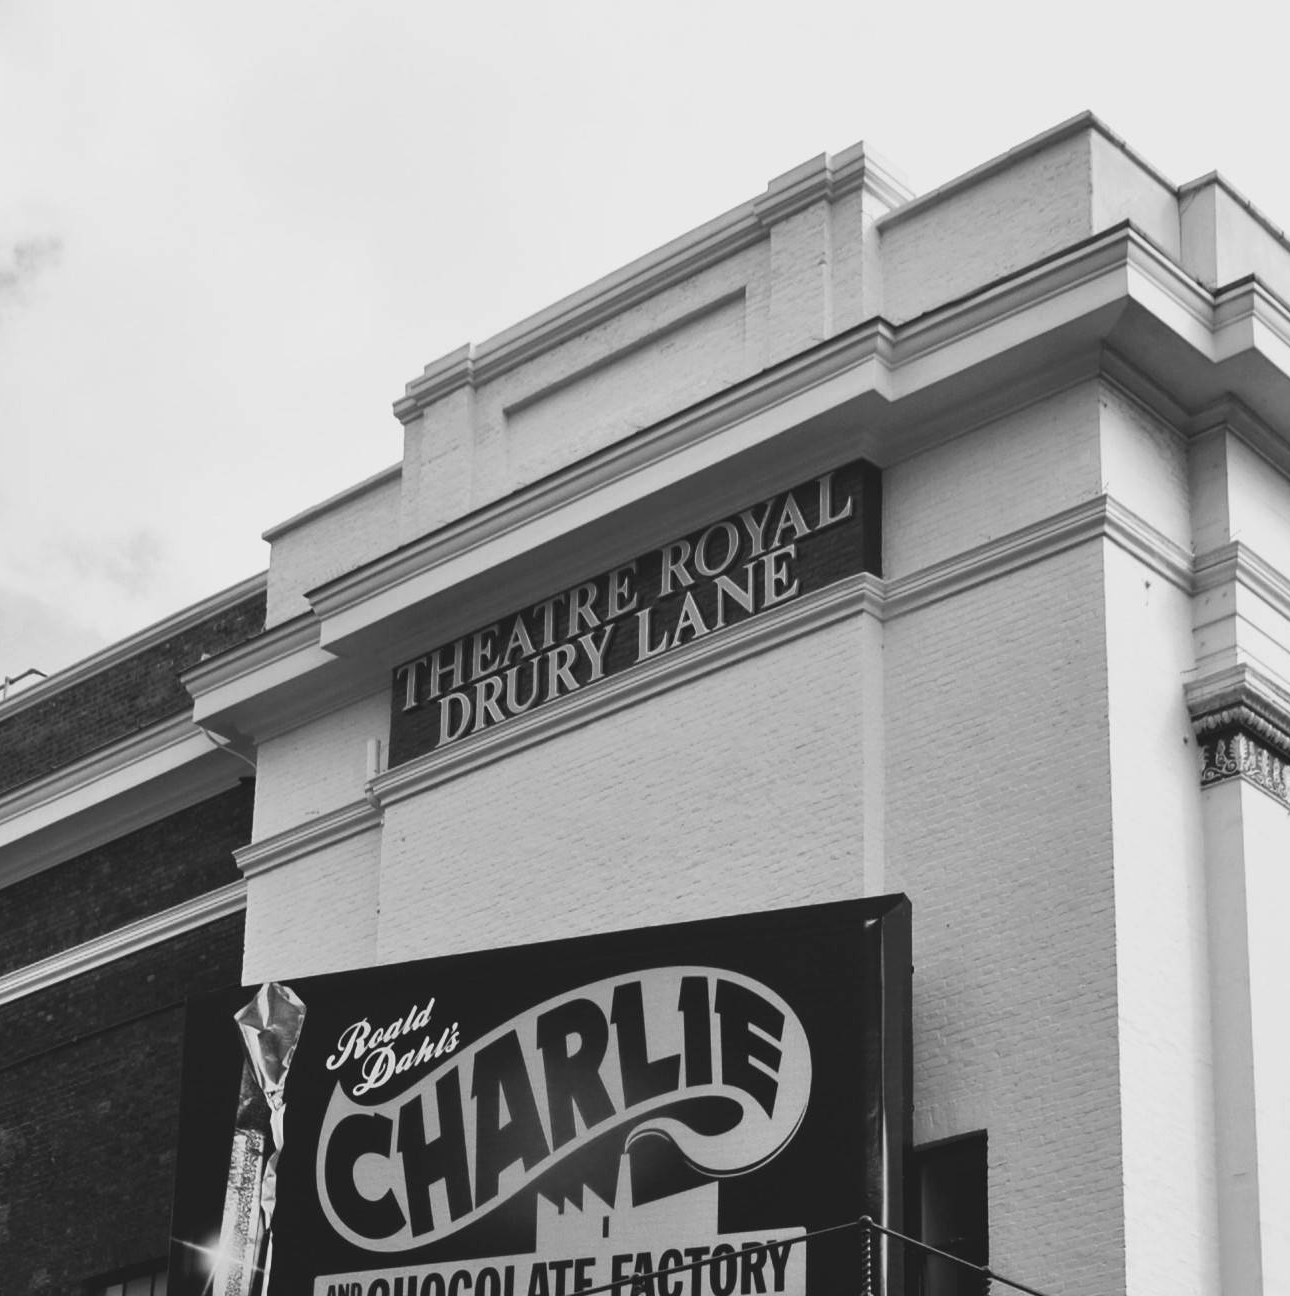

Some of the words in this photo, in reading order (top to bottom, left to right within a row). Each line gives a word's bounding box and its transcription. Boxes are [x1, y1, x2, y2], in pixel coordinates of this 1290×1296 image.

[397, 560, 639, 712] THEATRE
[660, 472, 854, 596] ROYAL
[435, 622, 616, 749] DRURY
[634, 544, 801, 666] LANE
[323, 974, 786, 1240] CHARLIE
[326, 997, 435, 1070] Roald
[352, 1021, 460, 1096] Dahl's
